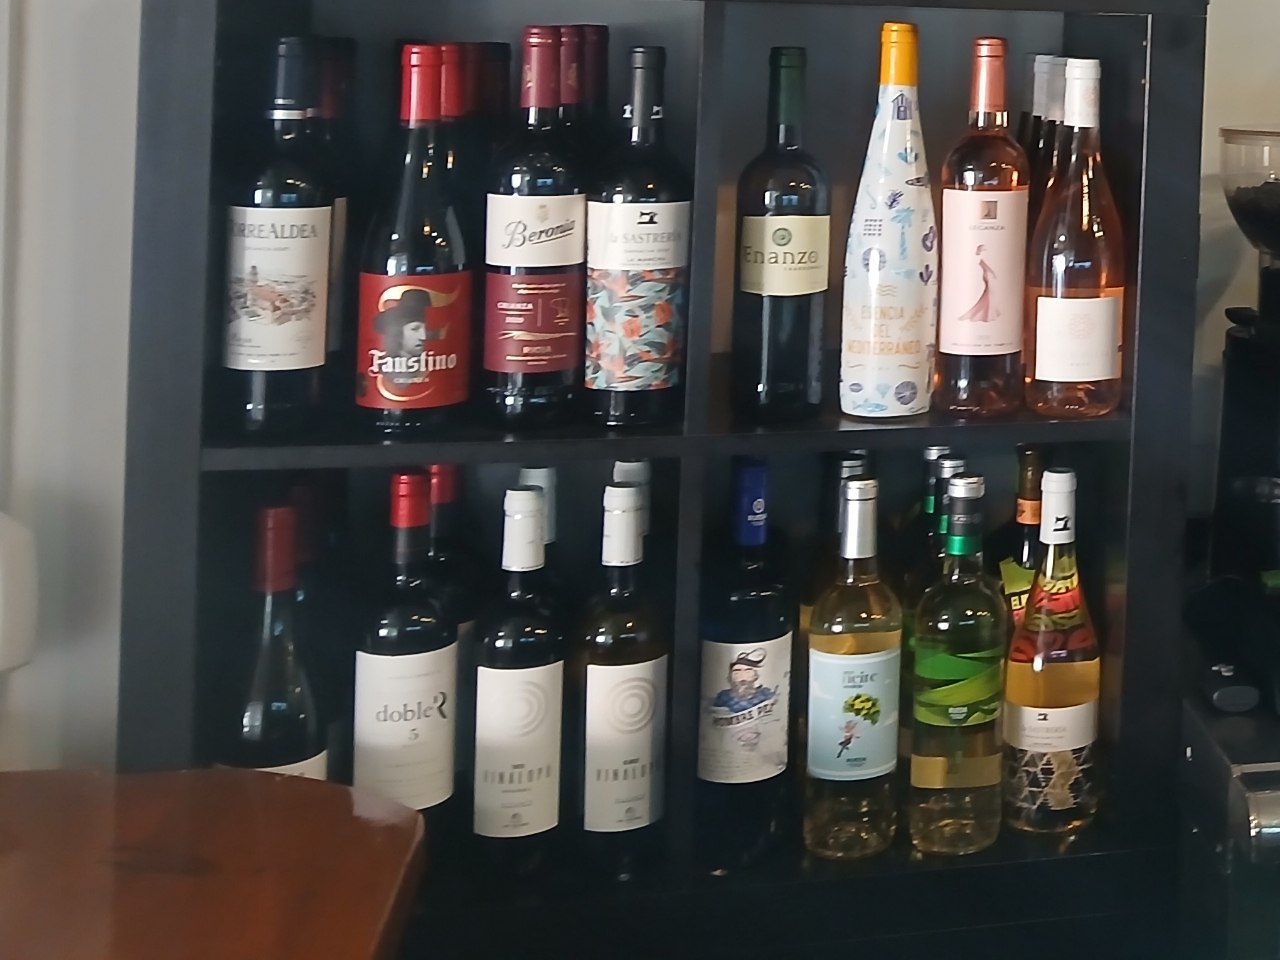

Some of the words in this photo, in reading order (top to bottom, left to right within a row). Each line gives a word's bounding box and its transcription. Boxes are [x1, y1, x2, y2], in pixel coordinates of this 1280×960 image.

[502, 220, 576, 249] Beronia
[743, 245, 818, 265] Enanzo
[367, 350, 457, 377] Faustino
